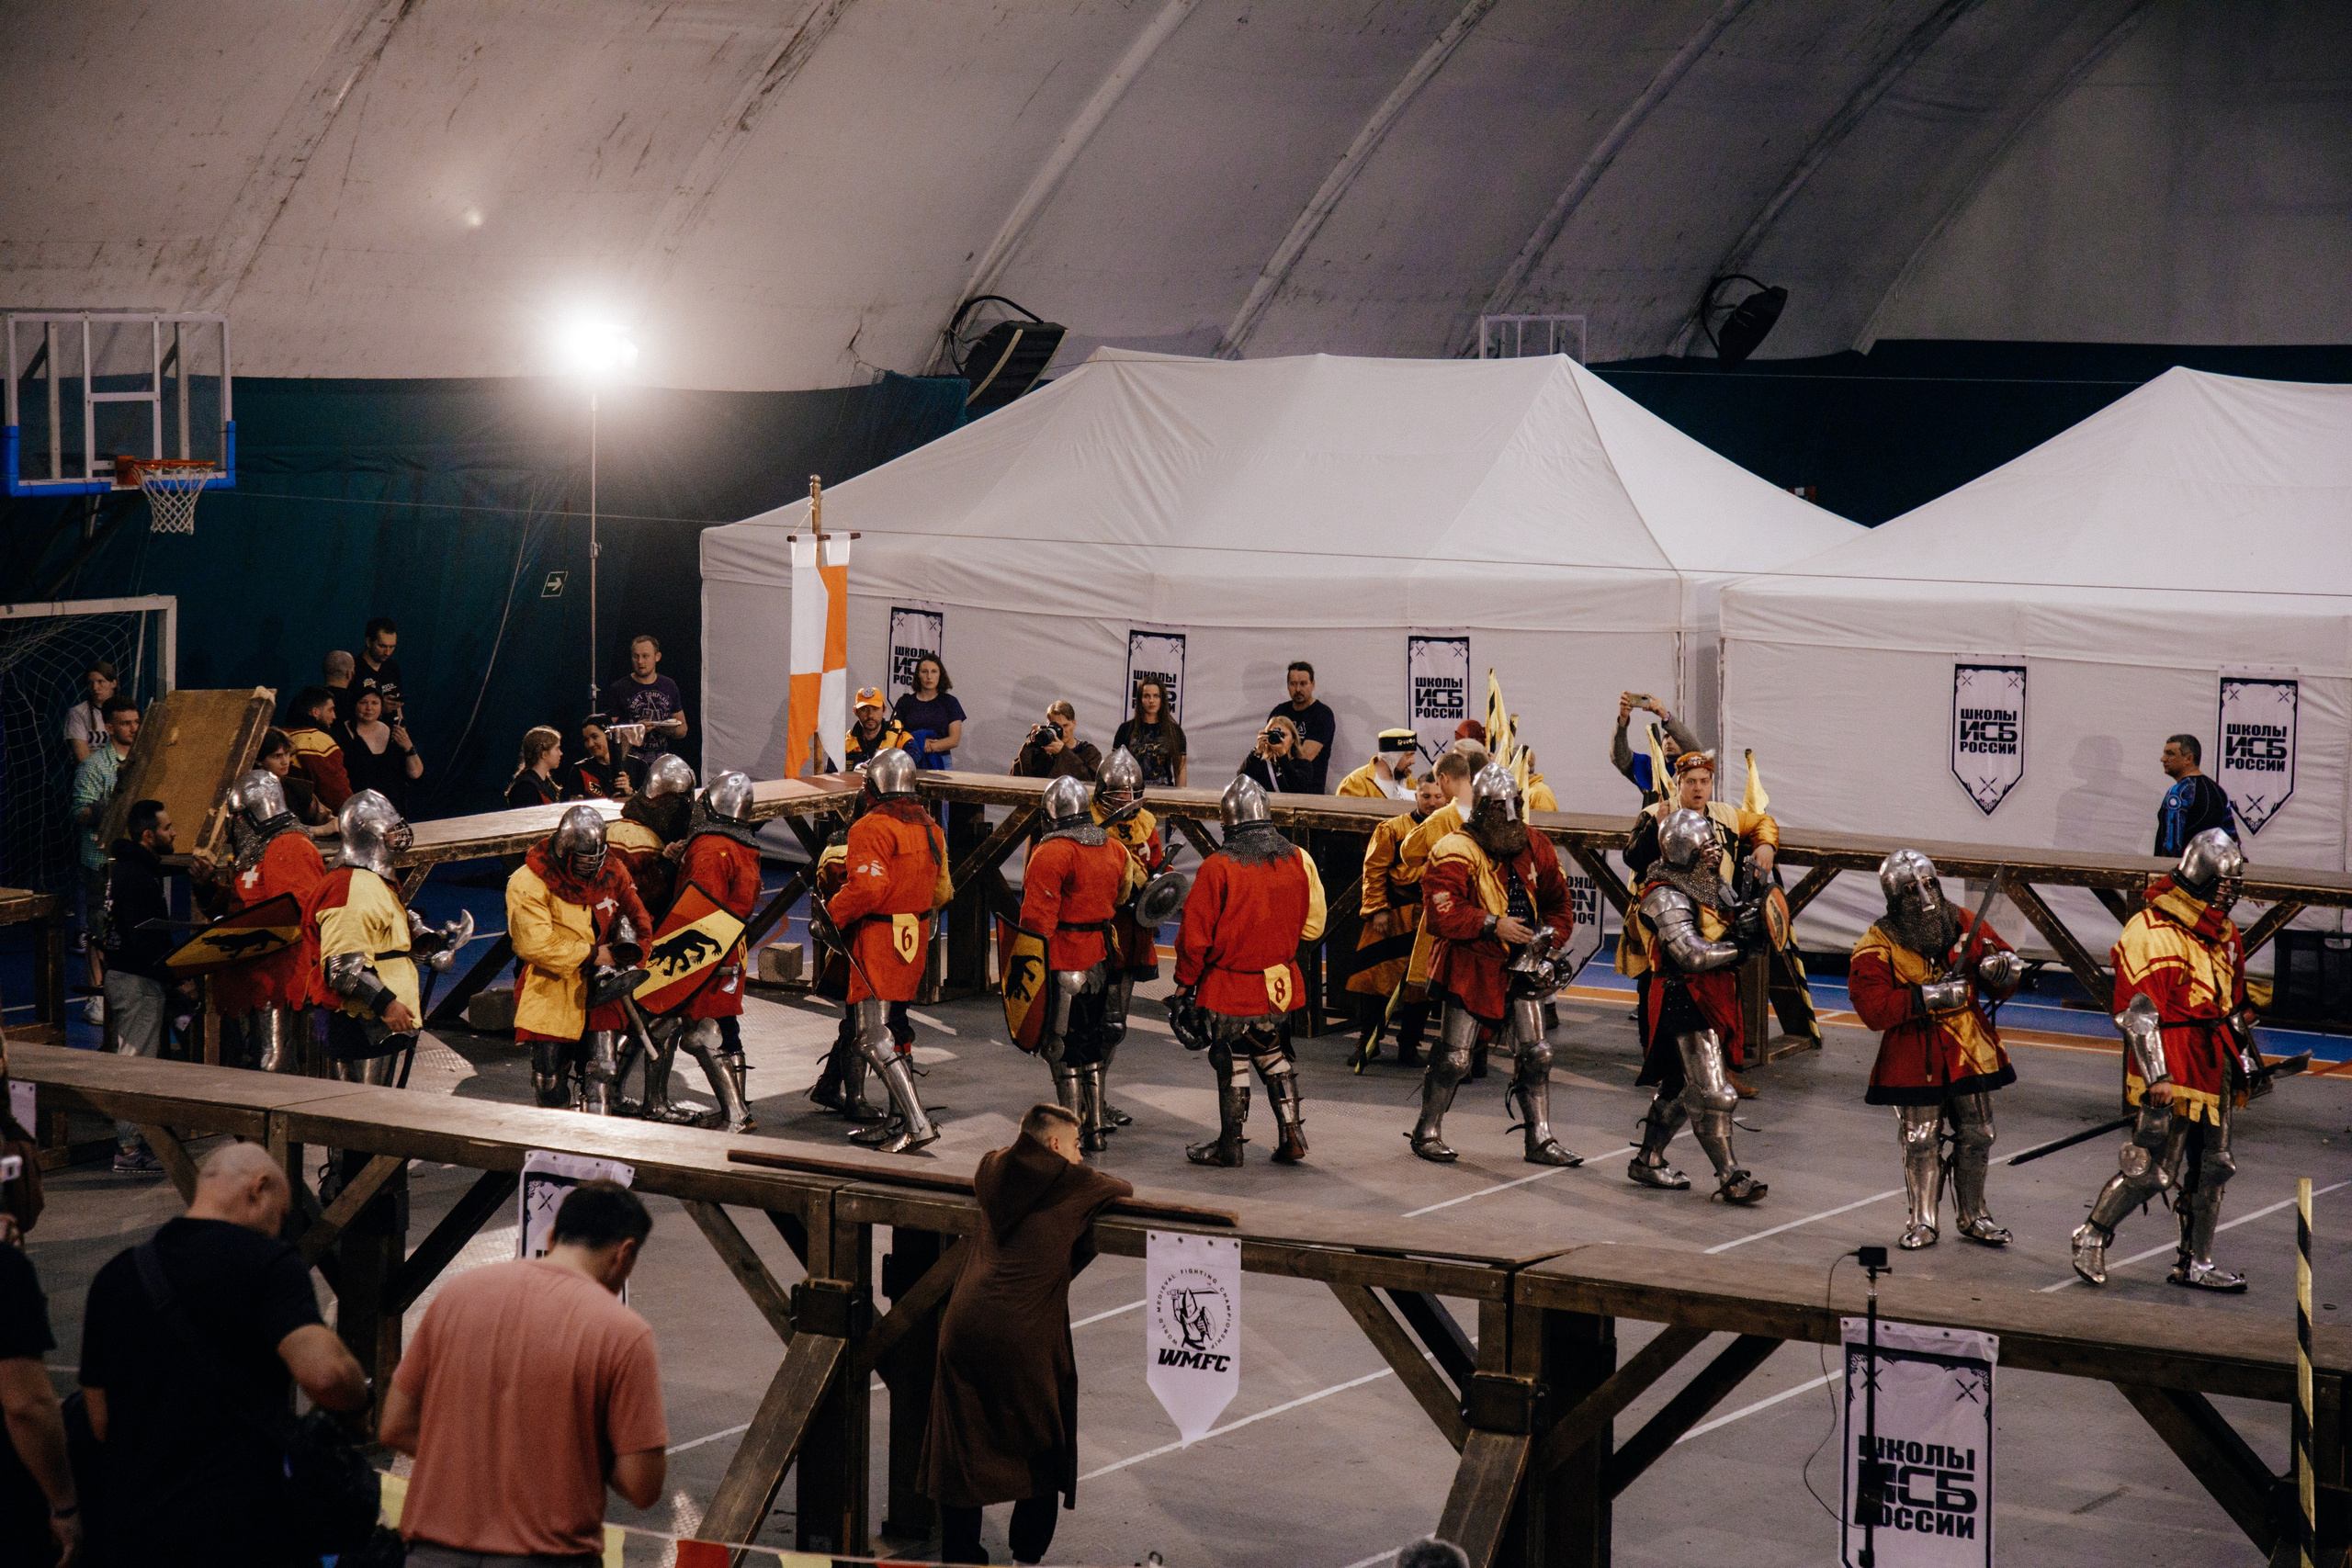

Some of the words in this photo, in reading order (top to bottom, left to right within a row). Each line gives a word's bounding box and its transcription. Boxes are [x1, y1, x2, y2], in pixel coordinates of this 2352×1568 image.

[895, 645, 935, 658] ШКОЛ
[893, 656, 922, 675] ИС
[893, 674, 913, 686] РОС
[1415, 677, 1463, 688] ШКОЛЫ
[1415, 688, 1464, 708] ИСБ
[1415, 707, 1463, 719] РОССИИ
[1960, 708, 2017, 721] ШКОЛЫ
[1960, 720, 2018, 742] ИСБ
[2226, 723, 2287, 738] ШКОЛЫ
[1960, 741, 2017, 754] РОССИИ
[2225, 736, 2288, 760] ИСБ
[2225, 758, 2286, 772] РОССИИ
[901, 925, 912, 952] 6
[1273, 977, 1285, 1003] 8
[1181, 1269, 1217, 1284] FIGHTING
[1157, 1274, 1176, 1313] MEDIEVAL
[1211, 1287, 1232, 1349] CHAMPIONSHIP
[1159, 1318, 1177, 1345] WORLD
[1158, 1348, 1231, 1372] WMFC
[1881, 1505, 1974, 1540] ОССИИ
